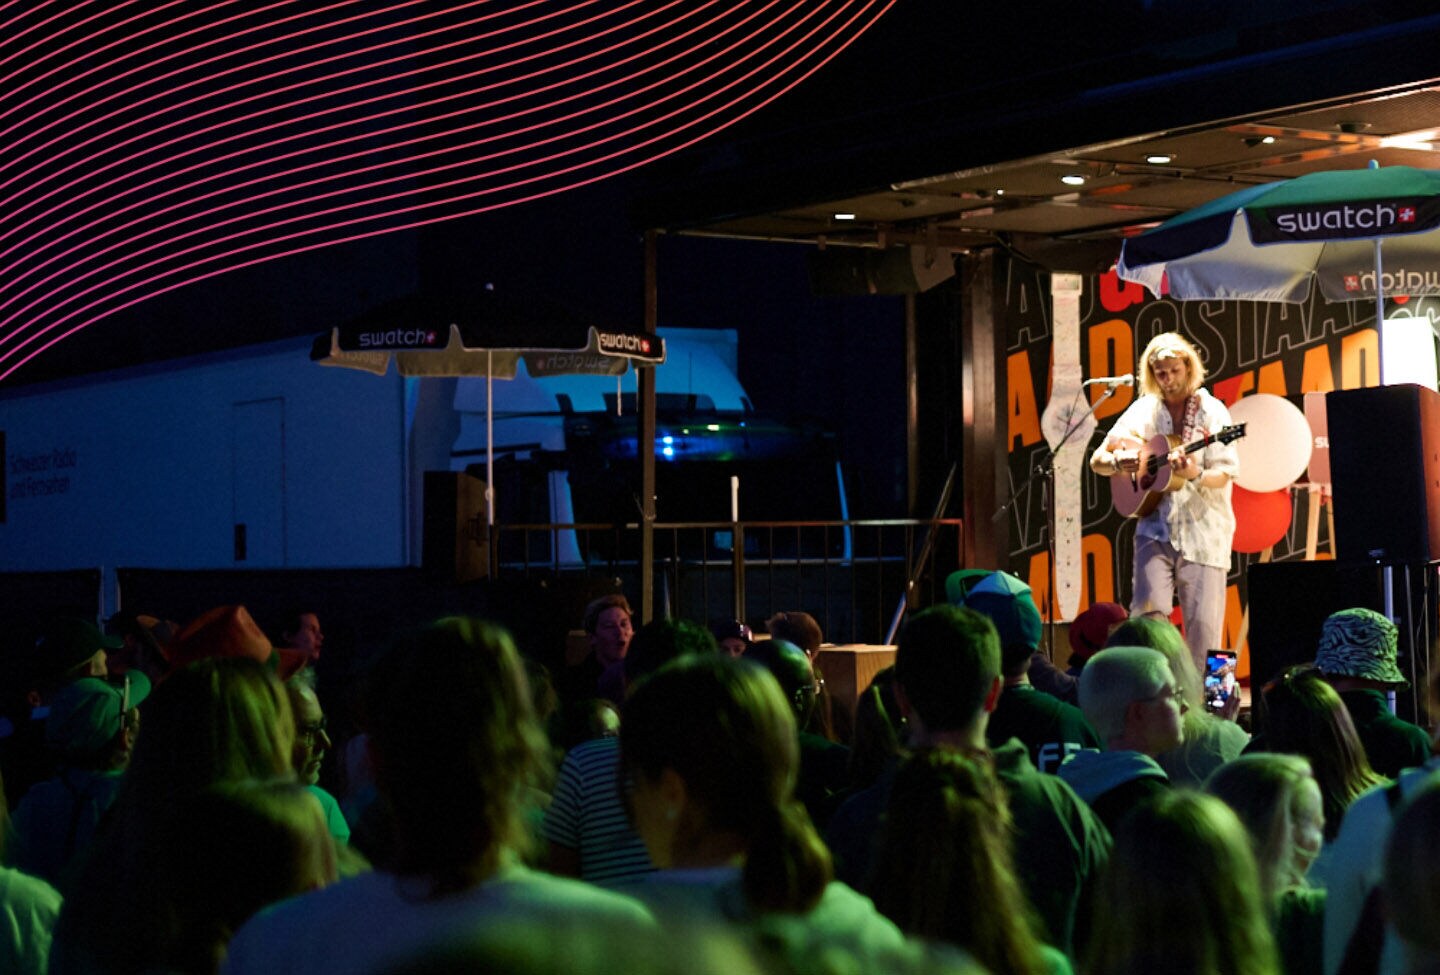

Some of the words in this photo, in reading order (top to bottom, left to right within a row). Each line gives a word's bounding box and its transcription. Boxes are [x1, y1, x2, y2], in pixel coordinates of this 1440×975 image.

[1277, 203, 1394, 232] swatch
[359, 329, 427, 347] swatch
[599, 332, 641, 352] swatch
